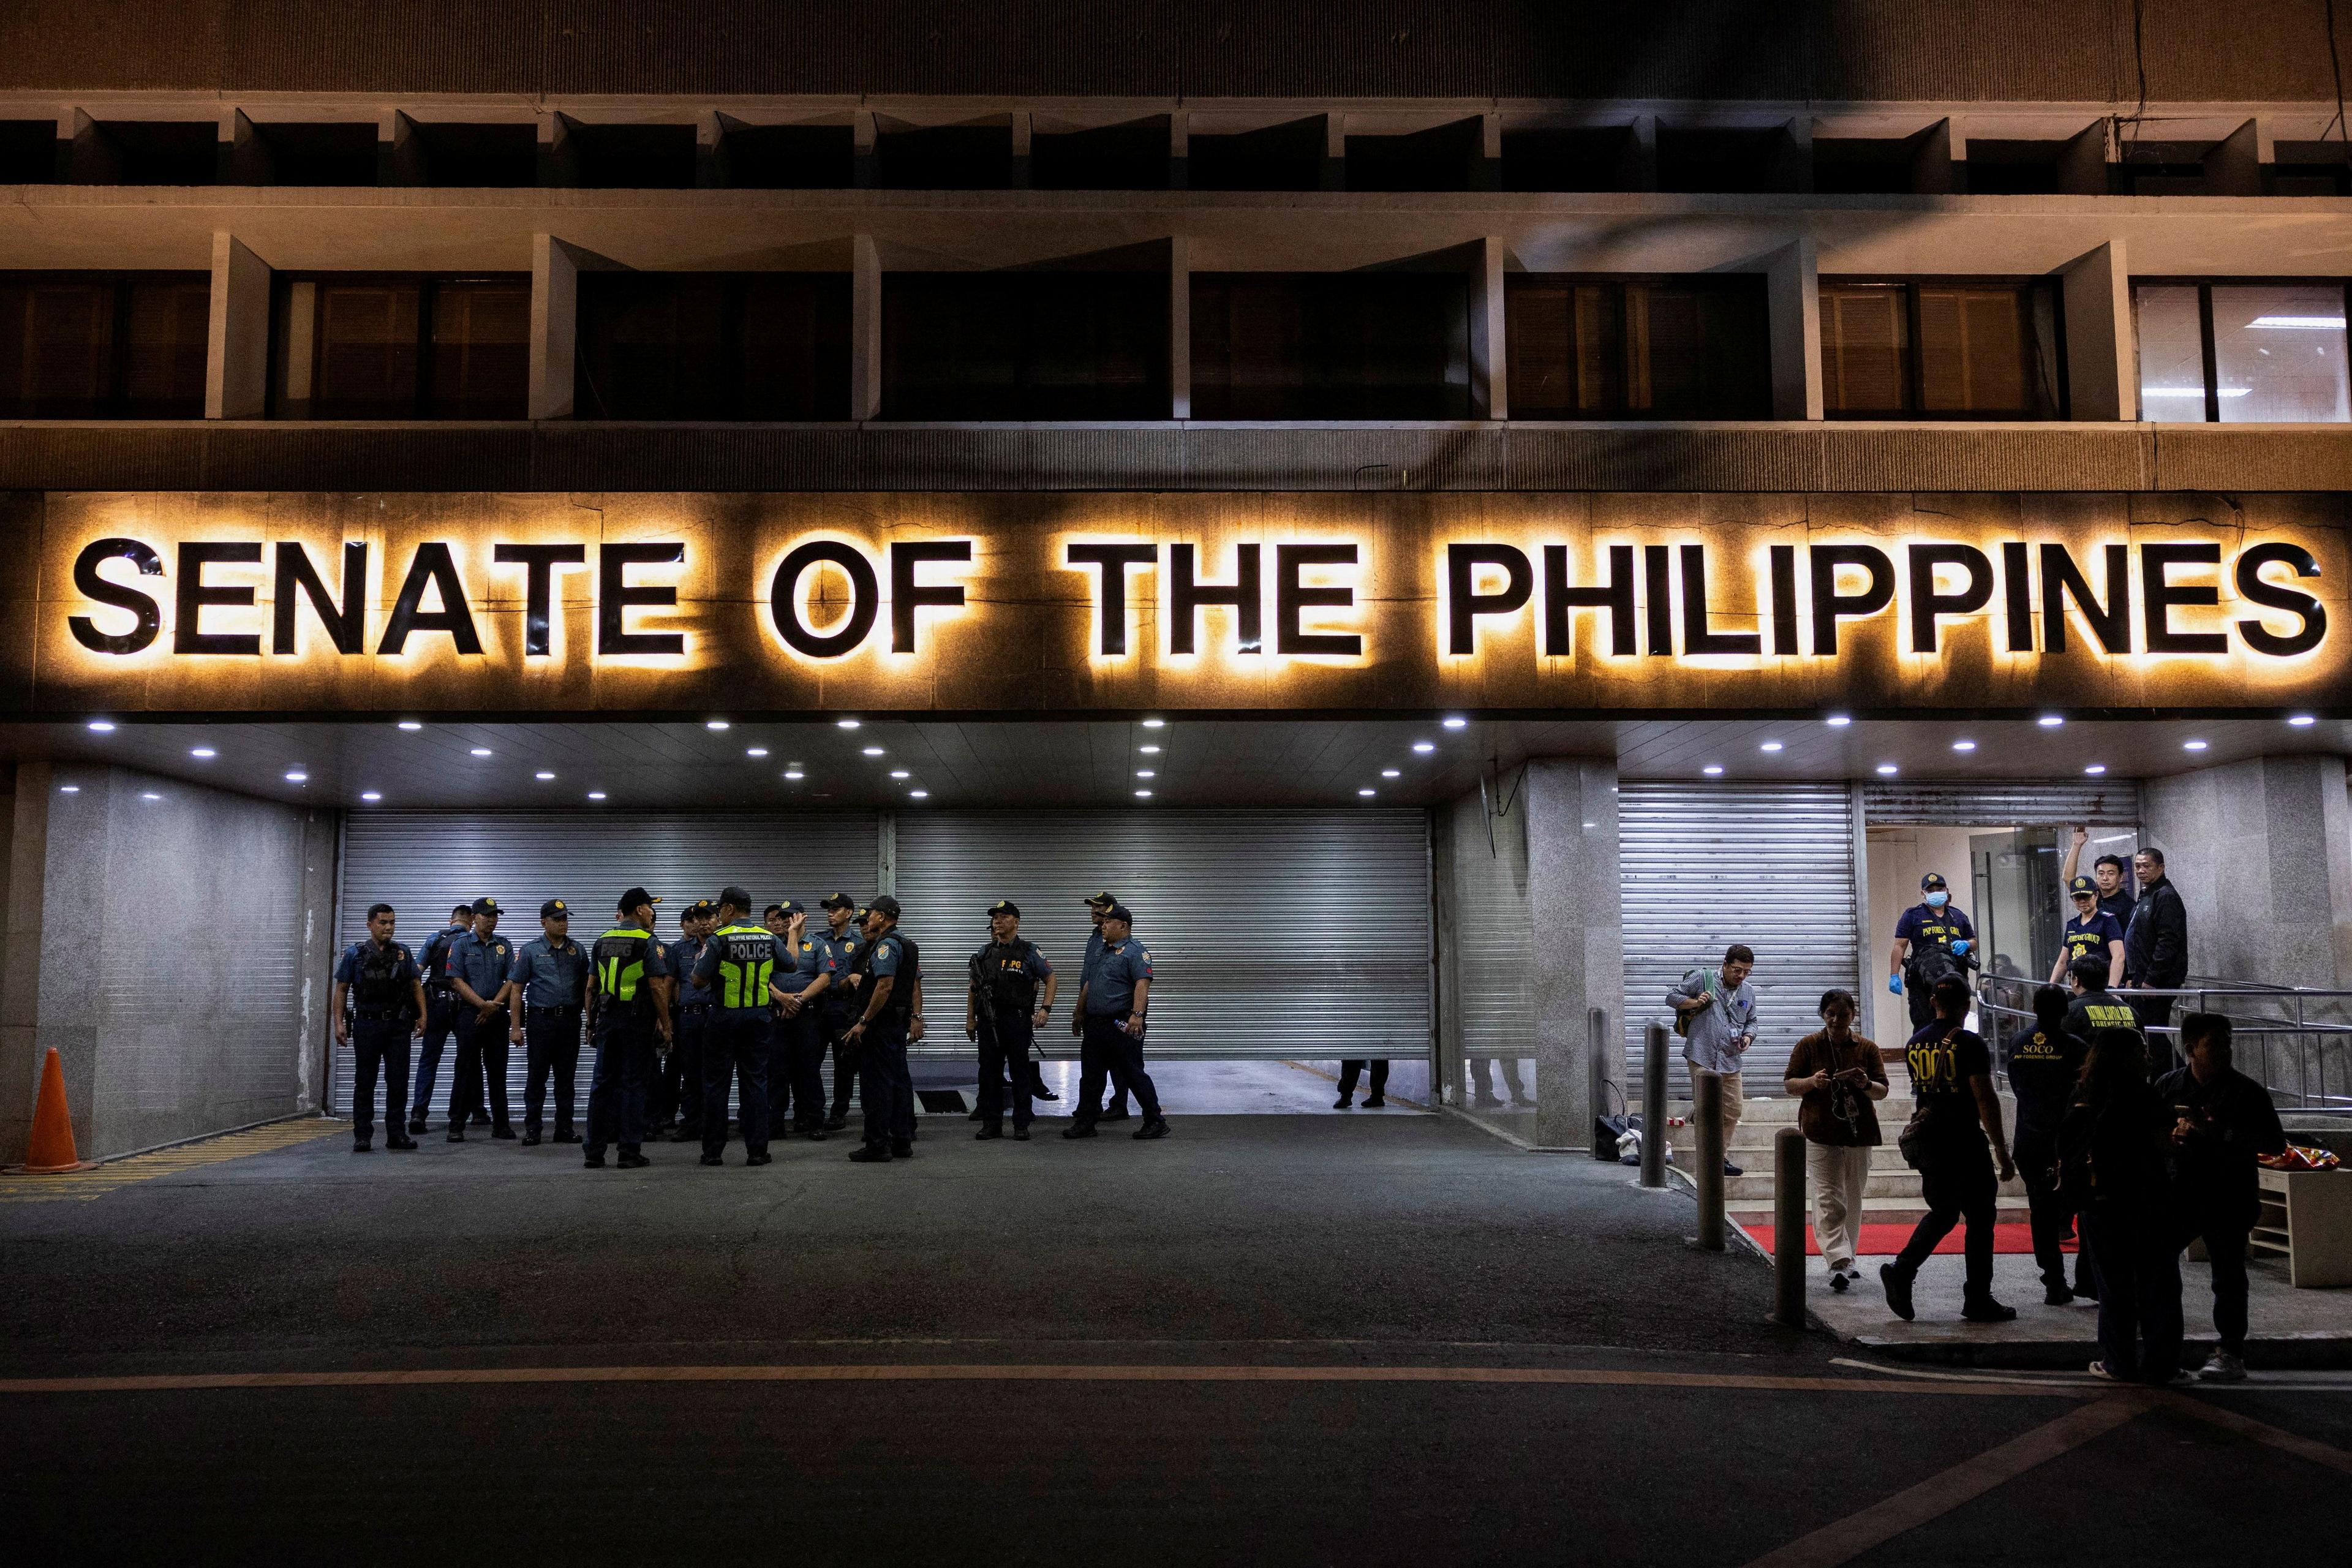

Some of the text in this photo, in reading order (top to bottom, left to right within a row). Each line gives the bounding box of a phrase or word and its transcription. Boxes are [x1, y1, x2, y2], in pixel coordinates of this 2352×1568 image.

[68, 538, 2328, 657] SENATE OF THE PHILIPPINES
[1923, 927, 1932, 937] PNP
[2084, 933, 2100, 944] GROUP
[730, 943, 771, 959] POLICE
[1909, 1042, 1958, 1051] POLIE
[2024, 1045, 2054, 1054] SOCO
